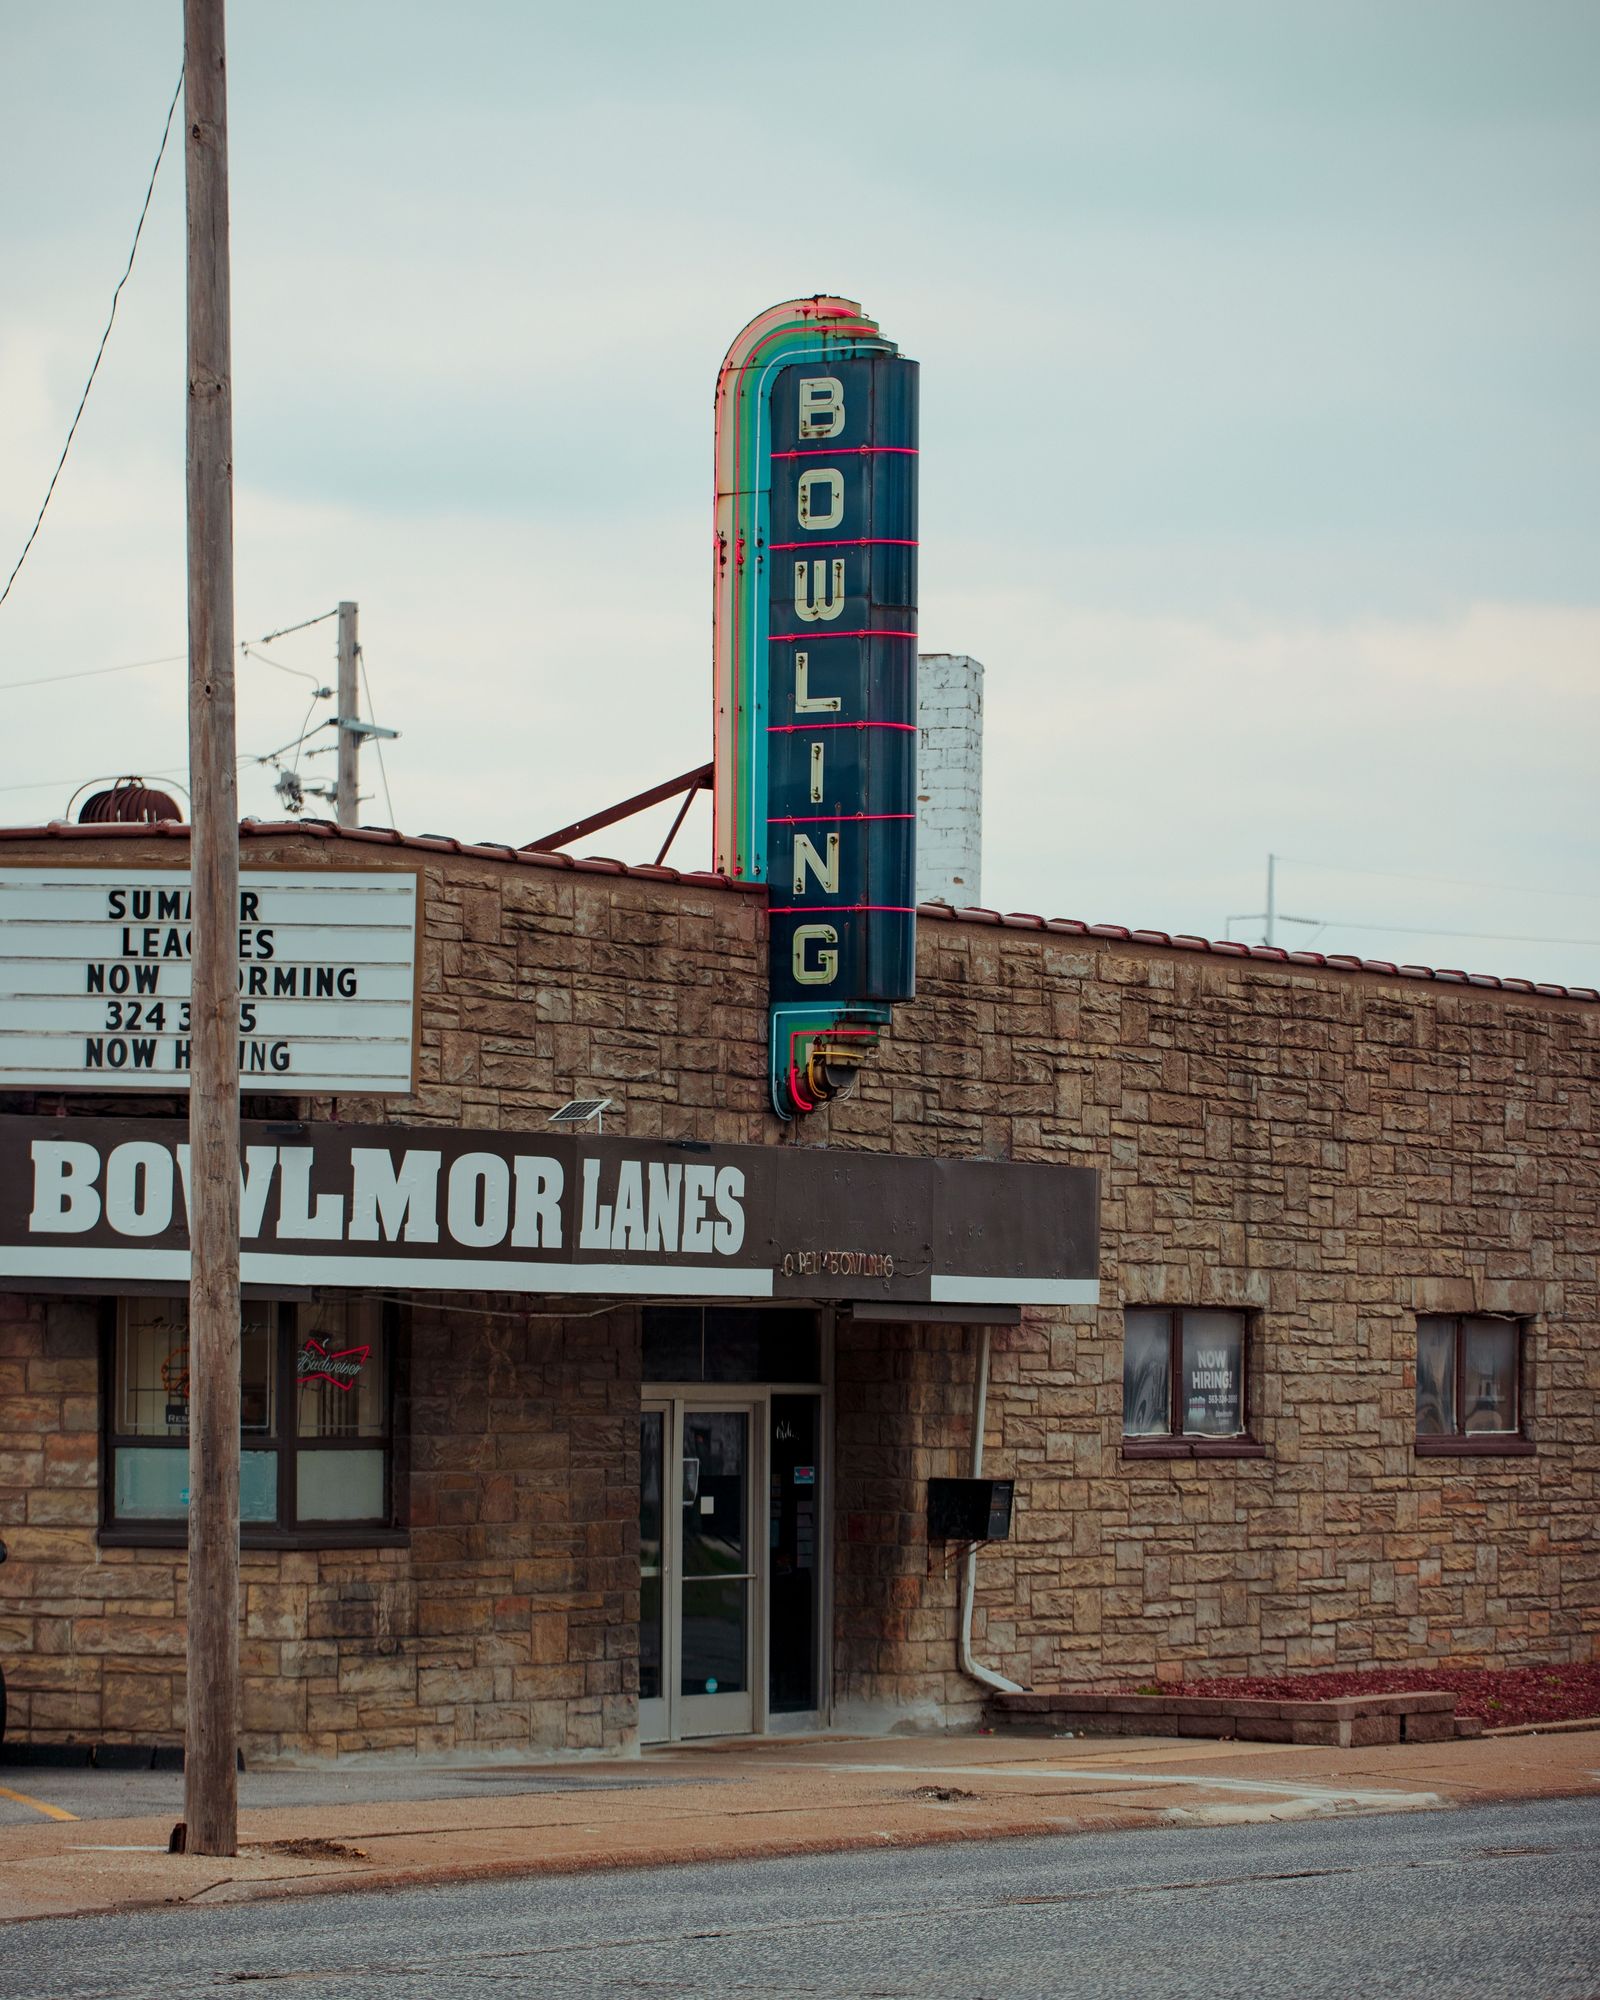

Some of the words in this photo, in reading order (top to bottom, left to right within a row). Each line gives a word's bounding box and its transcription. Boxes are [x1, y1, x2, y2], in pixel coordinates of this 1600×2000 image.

[793, 377, 845, 985] BOWLING
[108, 890, 260, 921] SUMR
[122, 927, 275, 960] LEAES
[86, 963, 160, 994] NOW
[239, 966, 357, 998] RMING
[105, 1001, 166, 1031] 324
[178, 1002, 257, 1033] 35
[85, 1038, 157, 1068] NOW
[174, 1039, 290, 1071] HING
[29, 1140, 563, 1249] BOWLMOR
[580, 1158, 745, 1255] LANES
[297, 1350, 362, 1376] Budweiser
[1197, 1350, 1228, 1368] NOW
[1191, 1370, 1233, 1389] HIRING!
